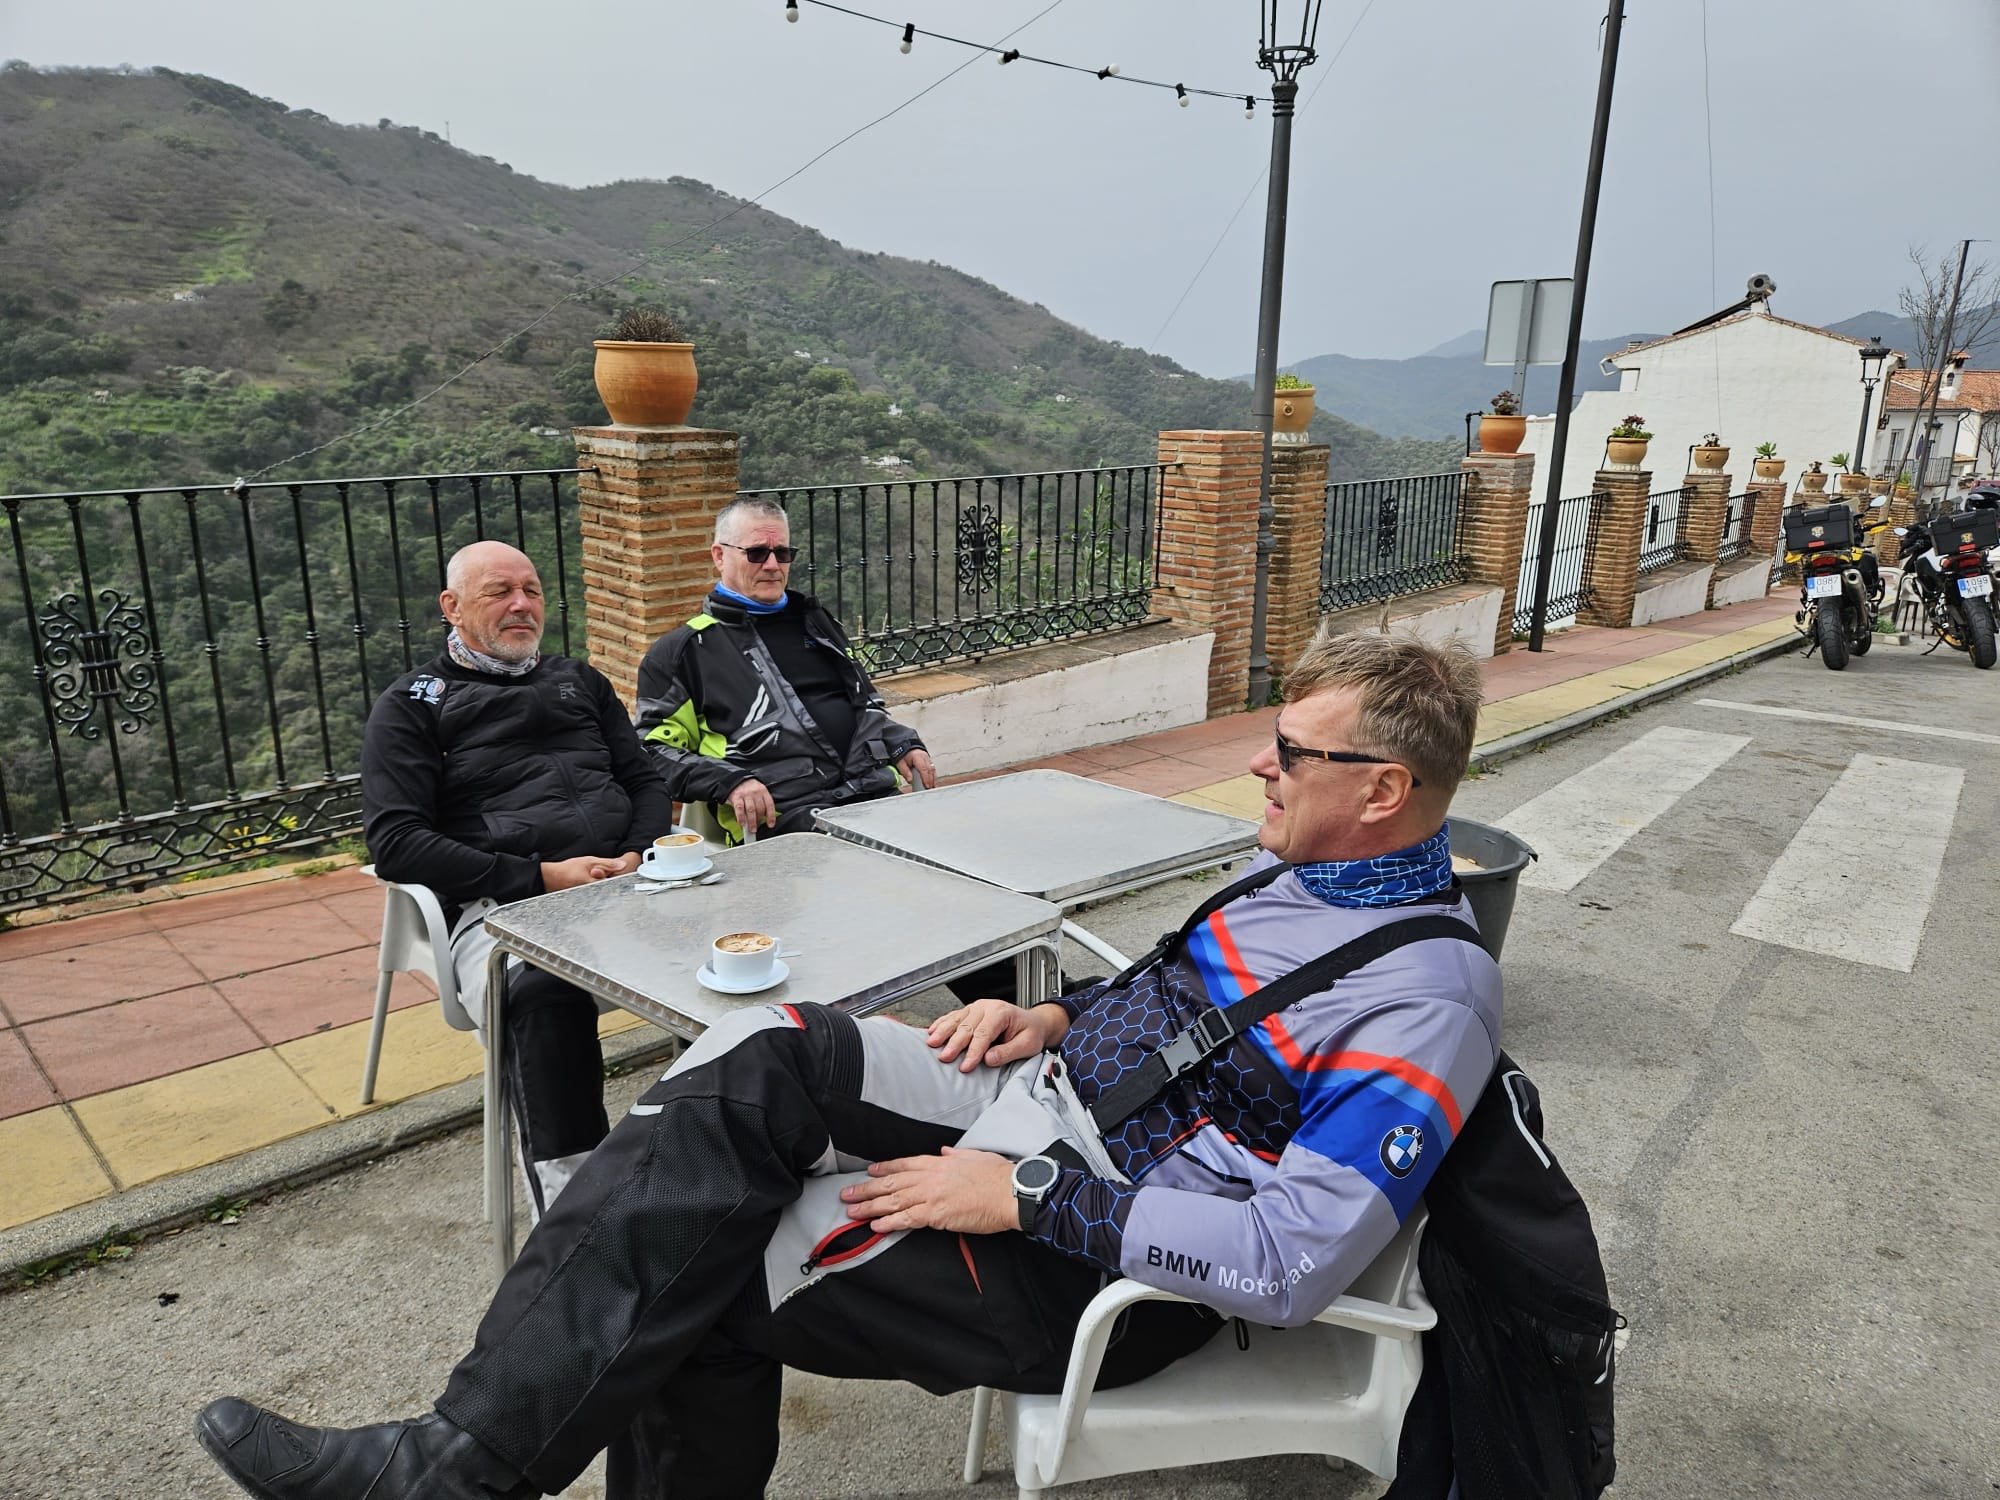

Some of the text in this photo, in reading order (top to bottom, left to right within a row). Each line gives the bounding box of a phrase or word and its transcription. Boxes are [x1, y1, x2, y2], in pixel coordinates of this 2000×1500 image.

[1966, 576, 1988, 586] 1099
[1394, 1127, 1423, 1154] BMW
[1147, 1244, 1212, 1282] BMW
